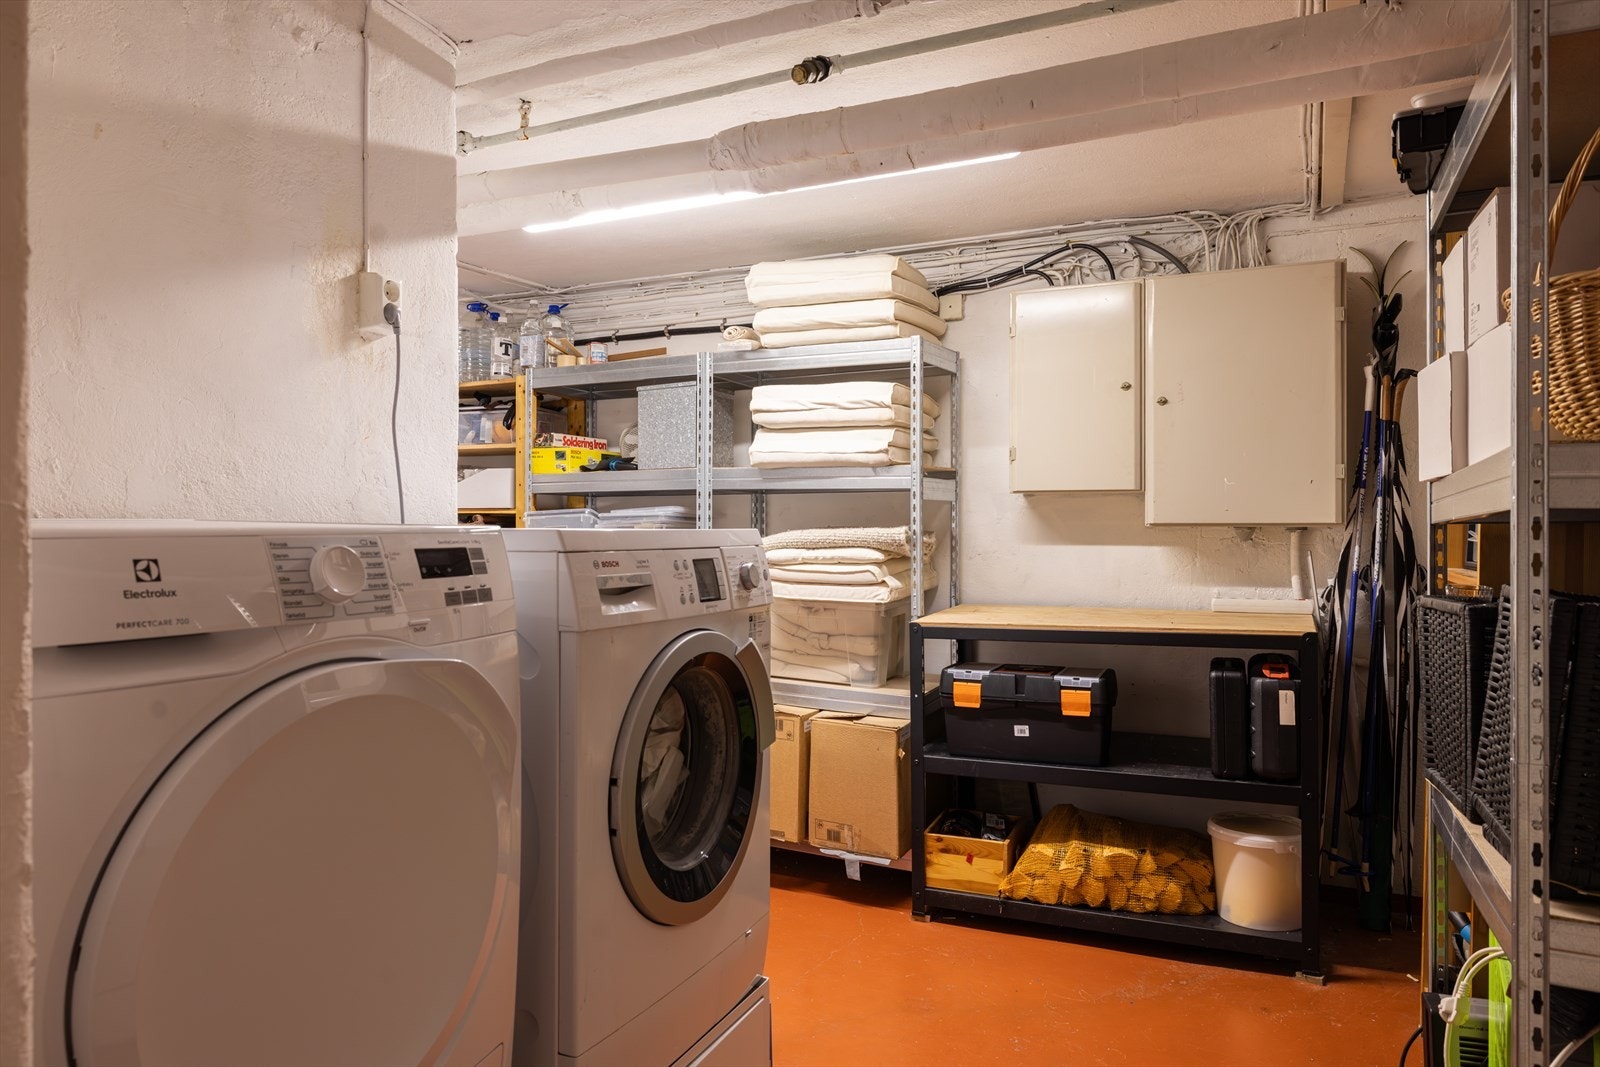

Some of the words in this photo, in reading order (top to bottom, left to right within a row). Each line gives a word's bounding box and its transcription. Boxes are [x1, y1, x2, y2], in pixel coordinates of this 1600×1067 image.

[562, 435, 593, 450] Soldering
[593, 439, 607, 450] Iron
[601, 560, 620, 568] BOSCH
[123, 588, 177, 600] Electrolux
[116, 619, 173, 630] PERFECTCARE
[176, 617, 190, 626] 700
